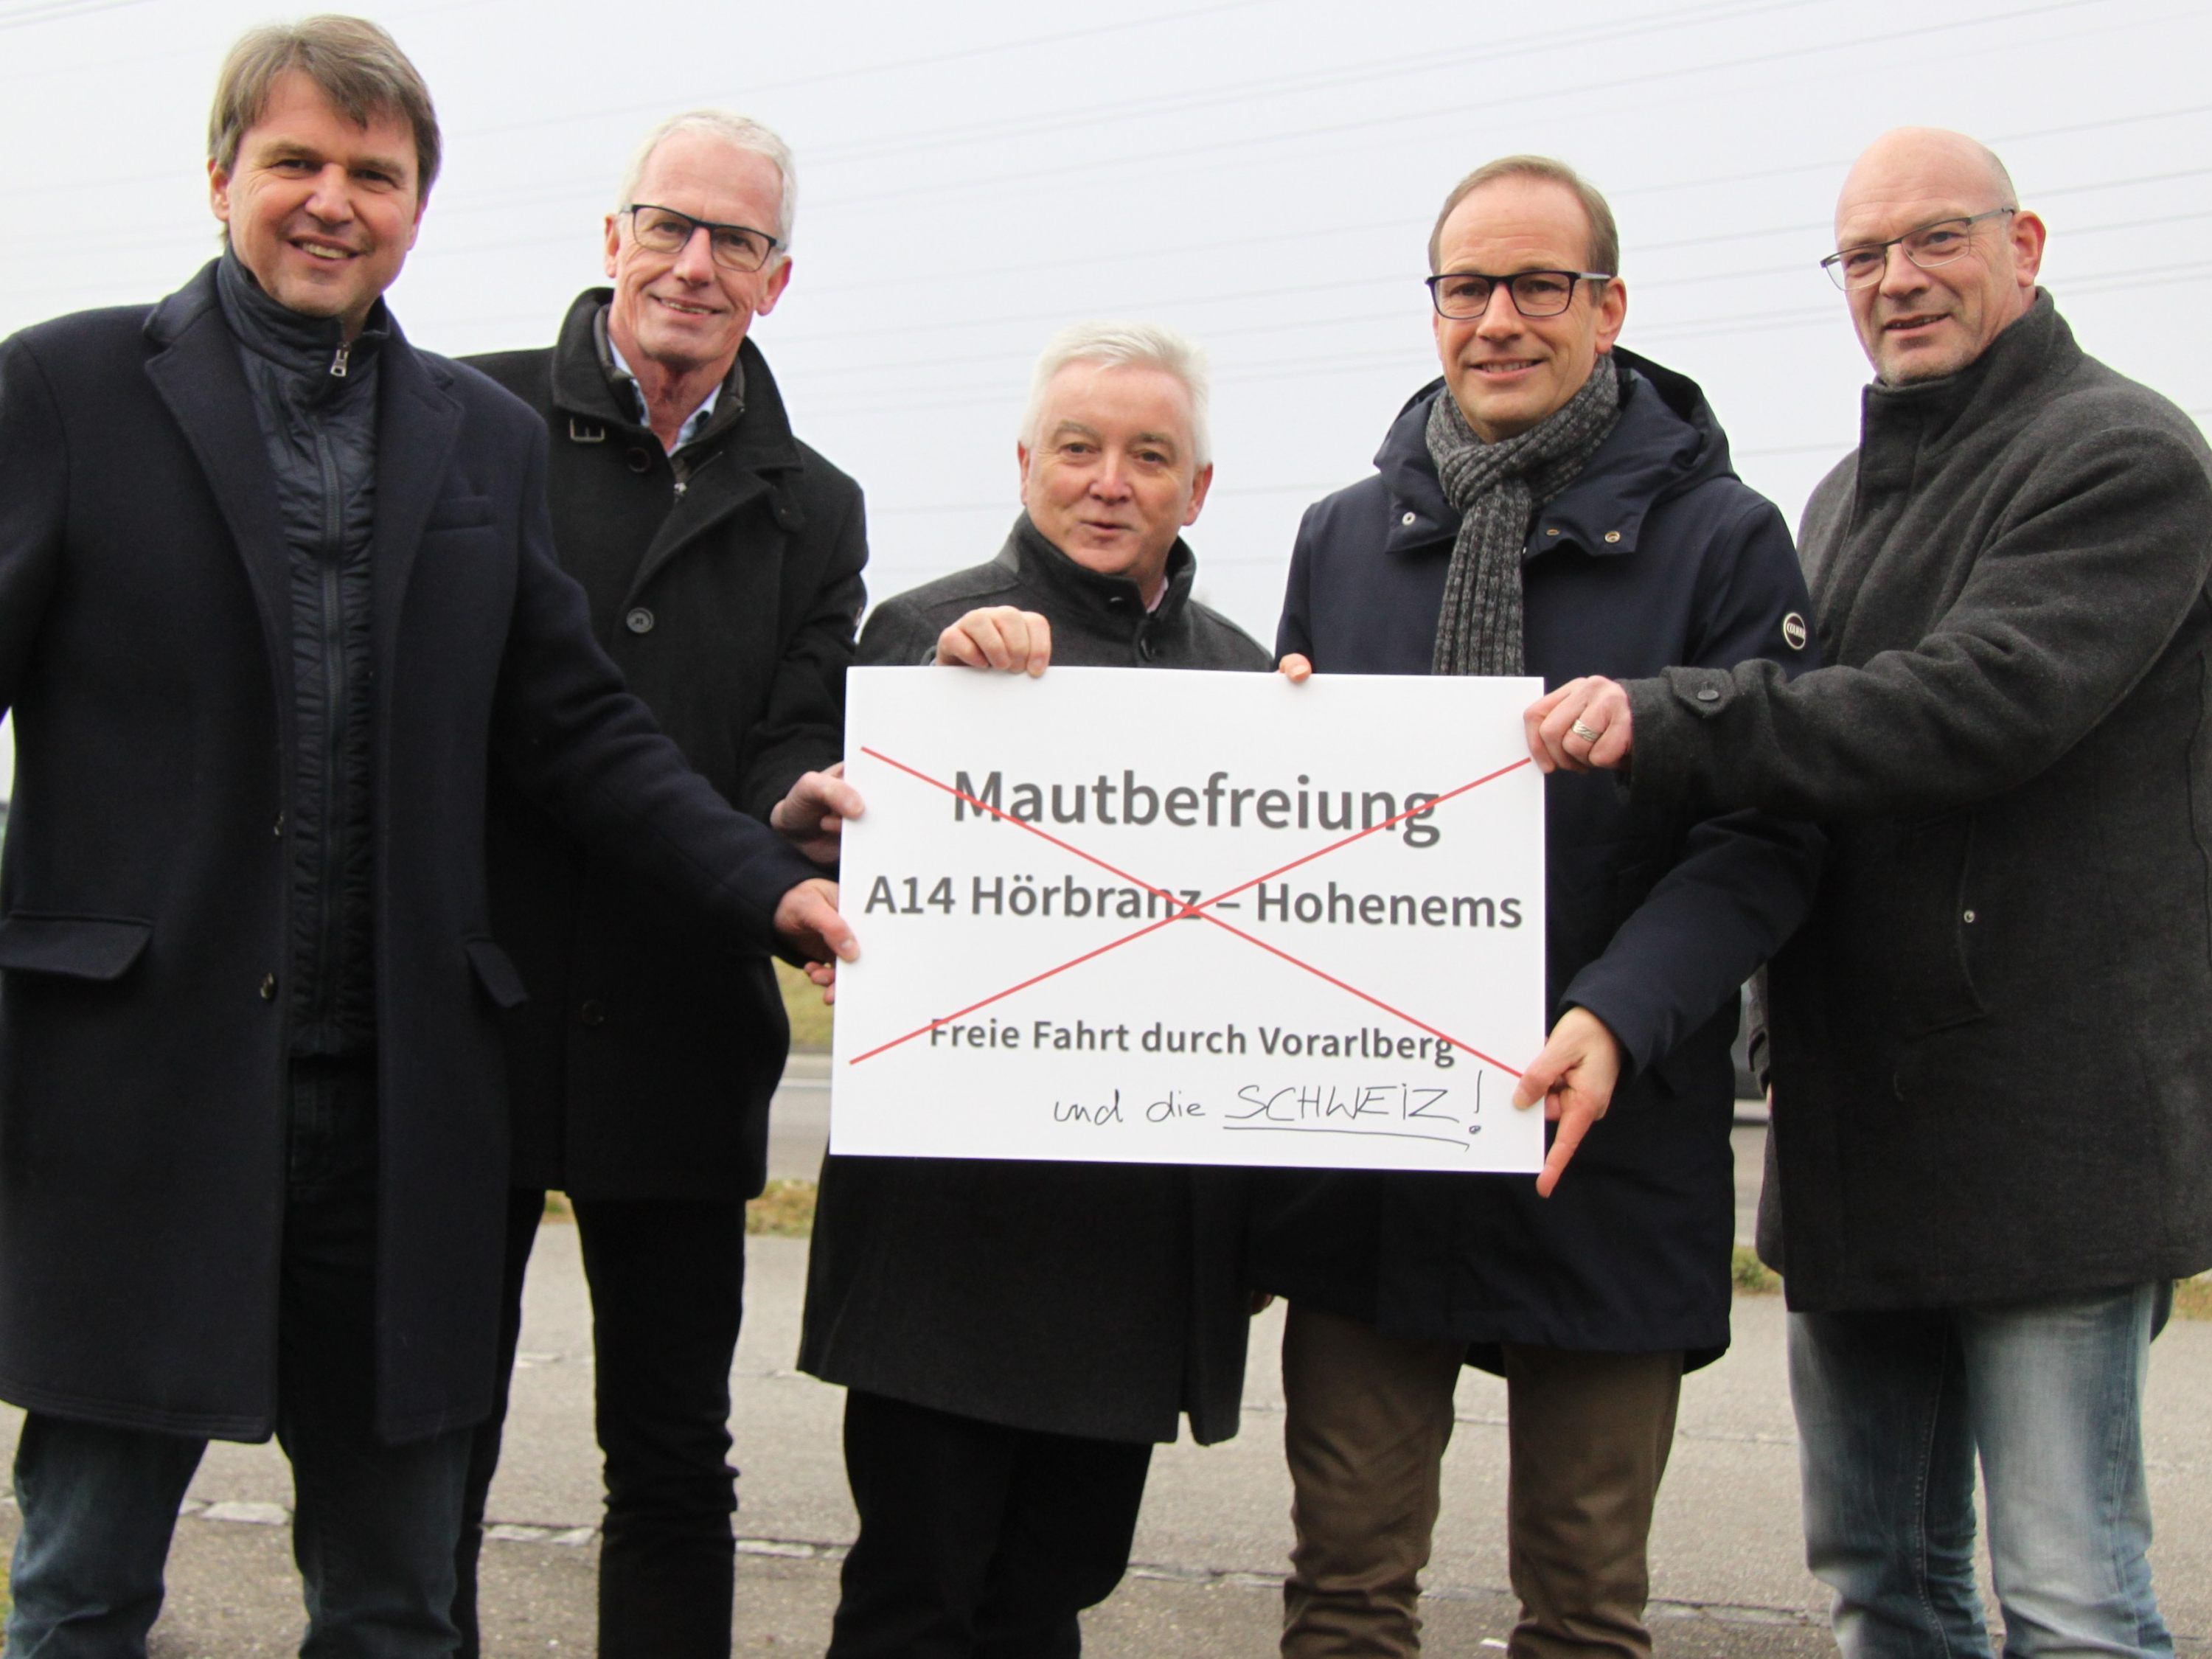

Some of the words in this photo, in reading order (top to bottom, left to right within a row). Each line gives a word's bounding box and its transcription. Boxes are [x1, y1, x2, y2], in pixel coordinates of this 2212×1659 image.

[953, 770, 1441, 848] Mautbefreiung
[864, 875, 956, 914] A14
[972, 874, 1202, 920] Hörbranz
[1258, 881, 1523, 928] Hohenems
[931, 1018, 1020, 1048] Freie
[1034, 1020, 1130, 1052] Fahrt
[1141, 1021, 1246, 1054] durch
[1258, 1027, 1455, 1067] Vorarlberg
[1054, 1088, 1124, 1126] und
[1146, 1091, 1206, 1122] die
